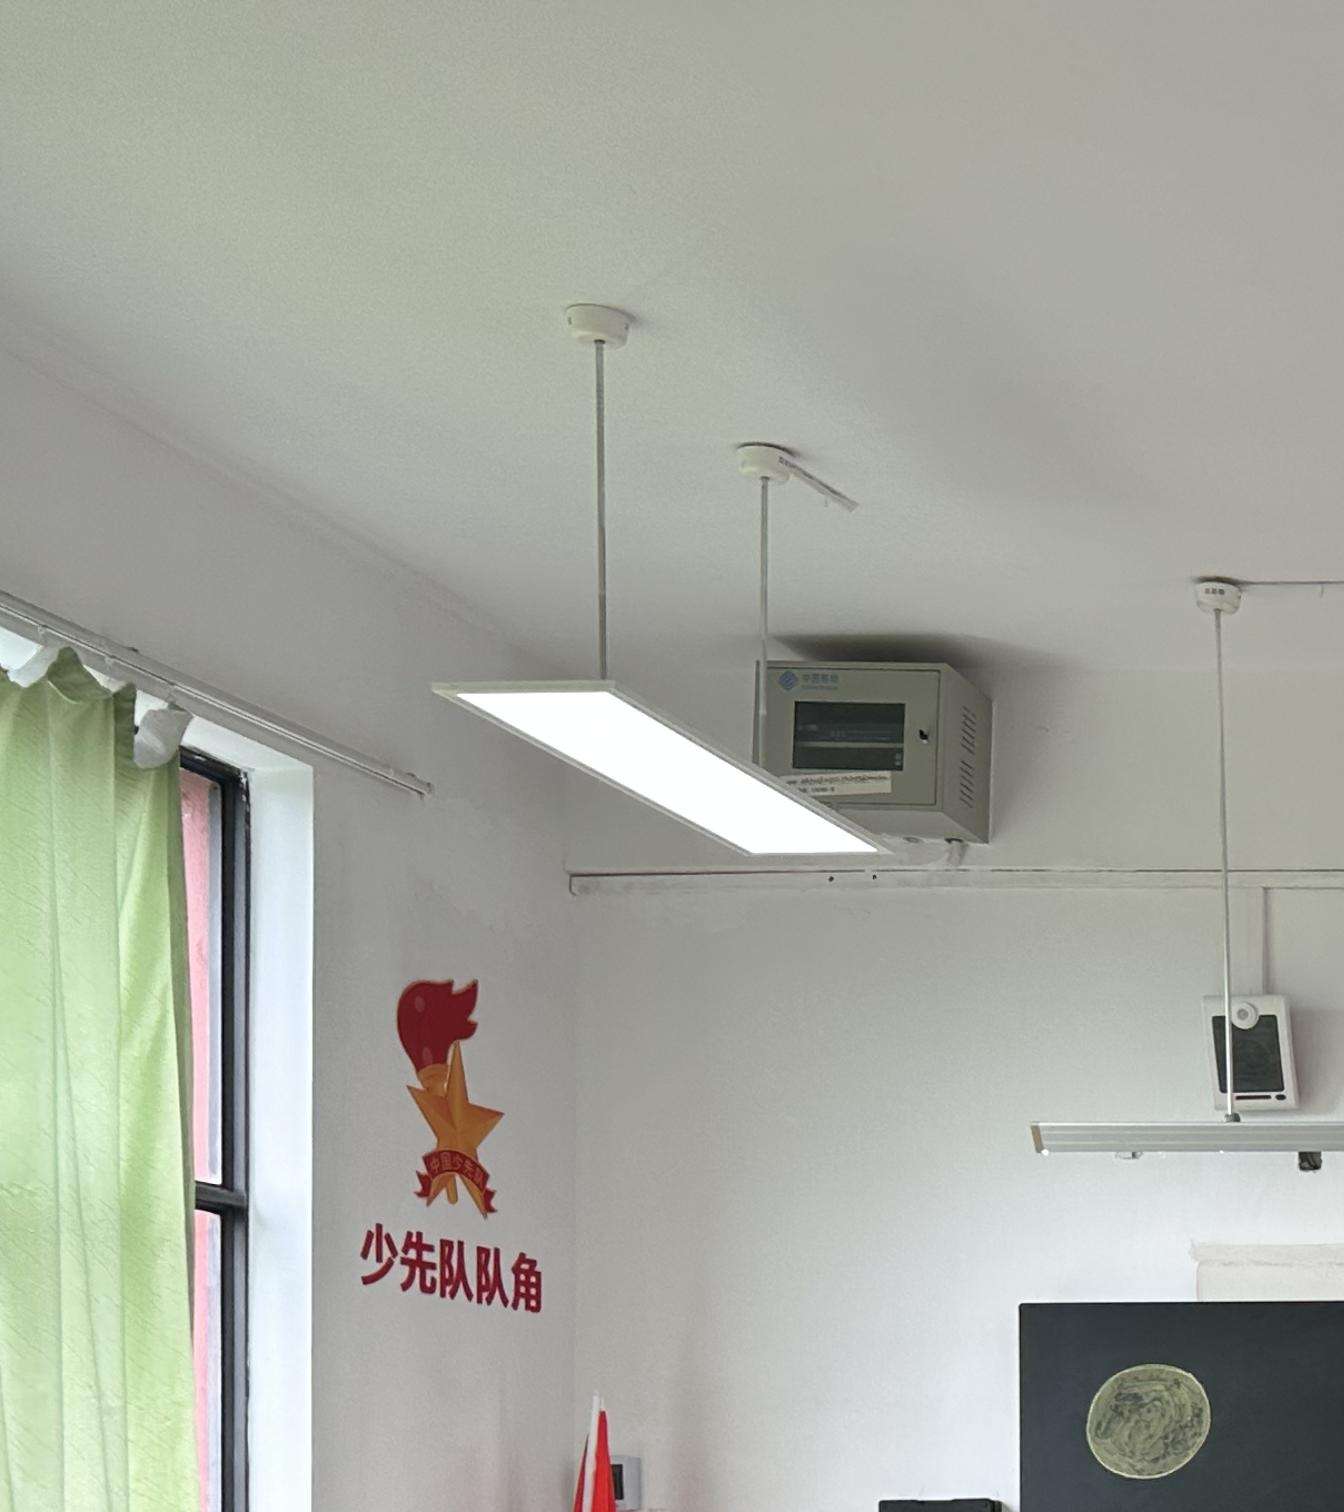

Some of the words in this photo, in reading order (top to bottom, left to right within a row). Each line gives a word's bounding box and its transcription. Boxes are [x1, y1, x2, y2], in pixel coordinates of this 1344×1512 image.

[360, 1223, 543, 1313] 少先队队角
